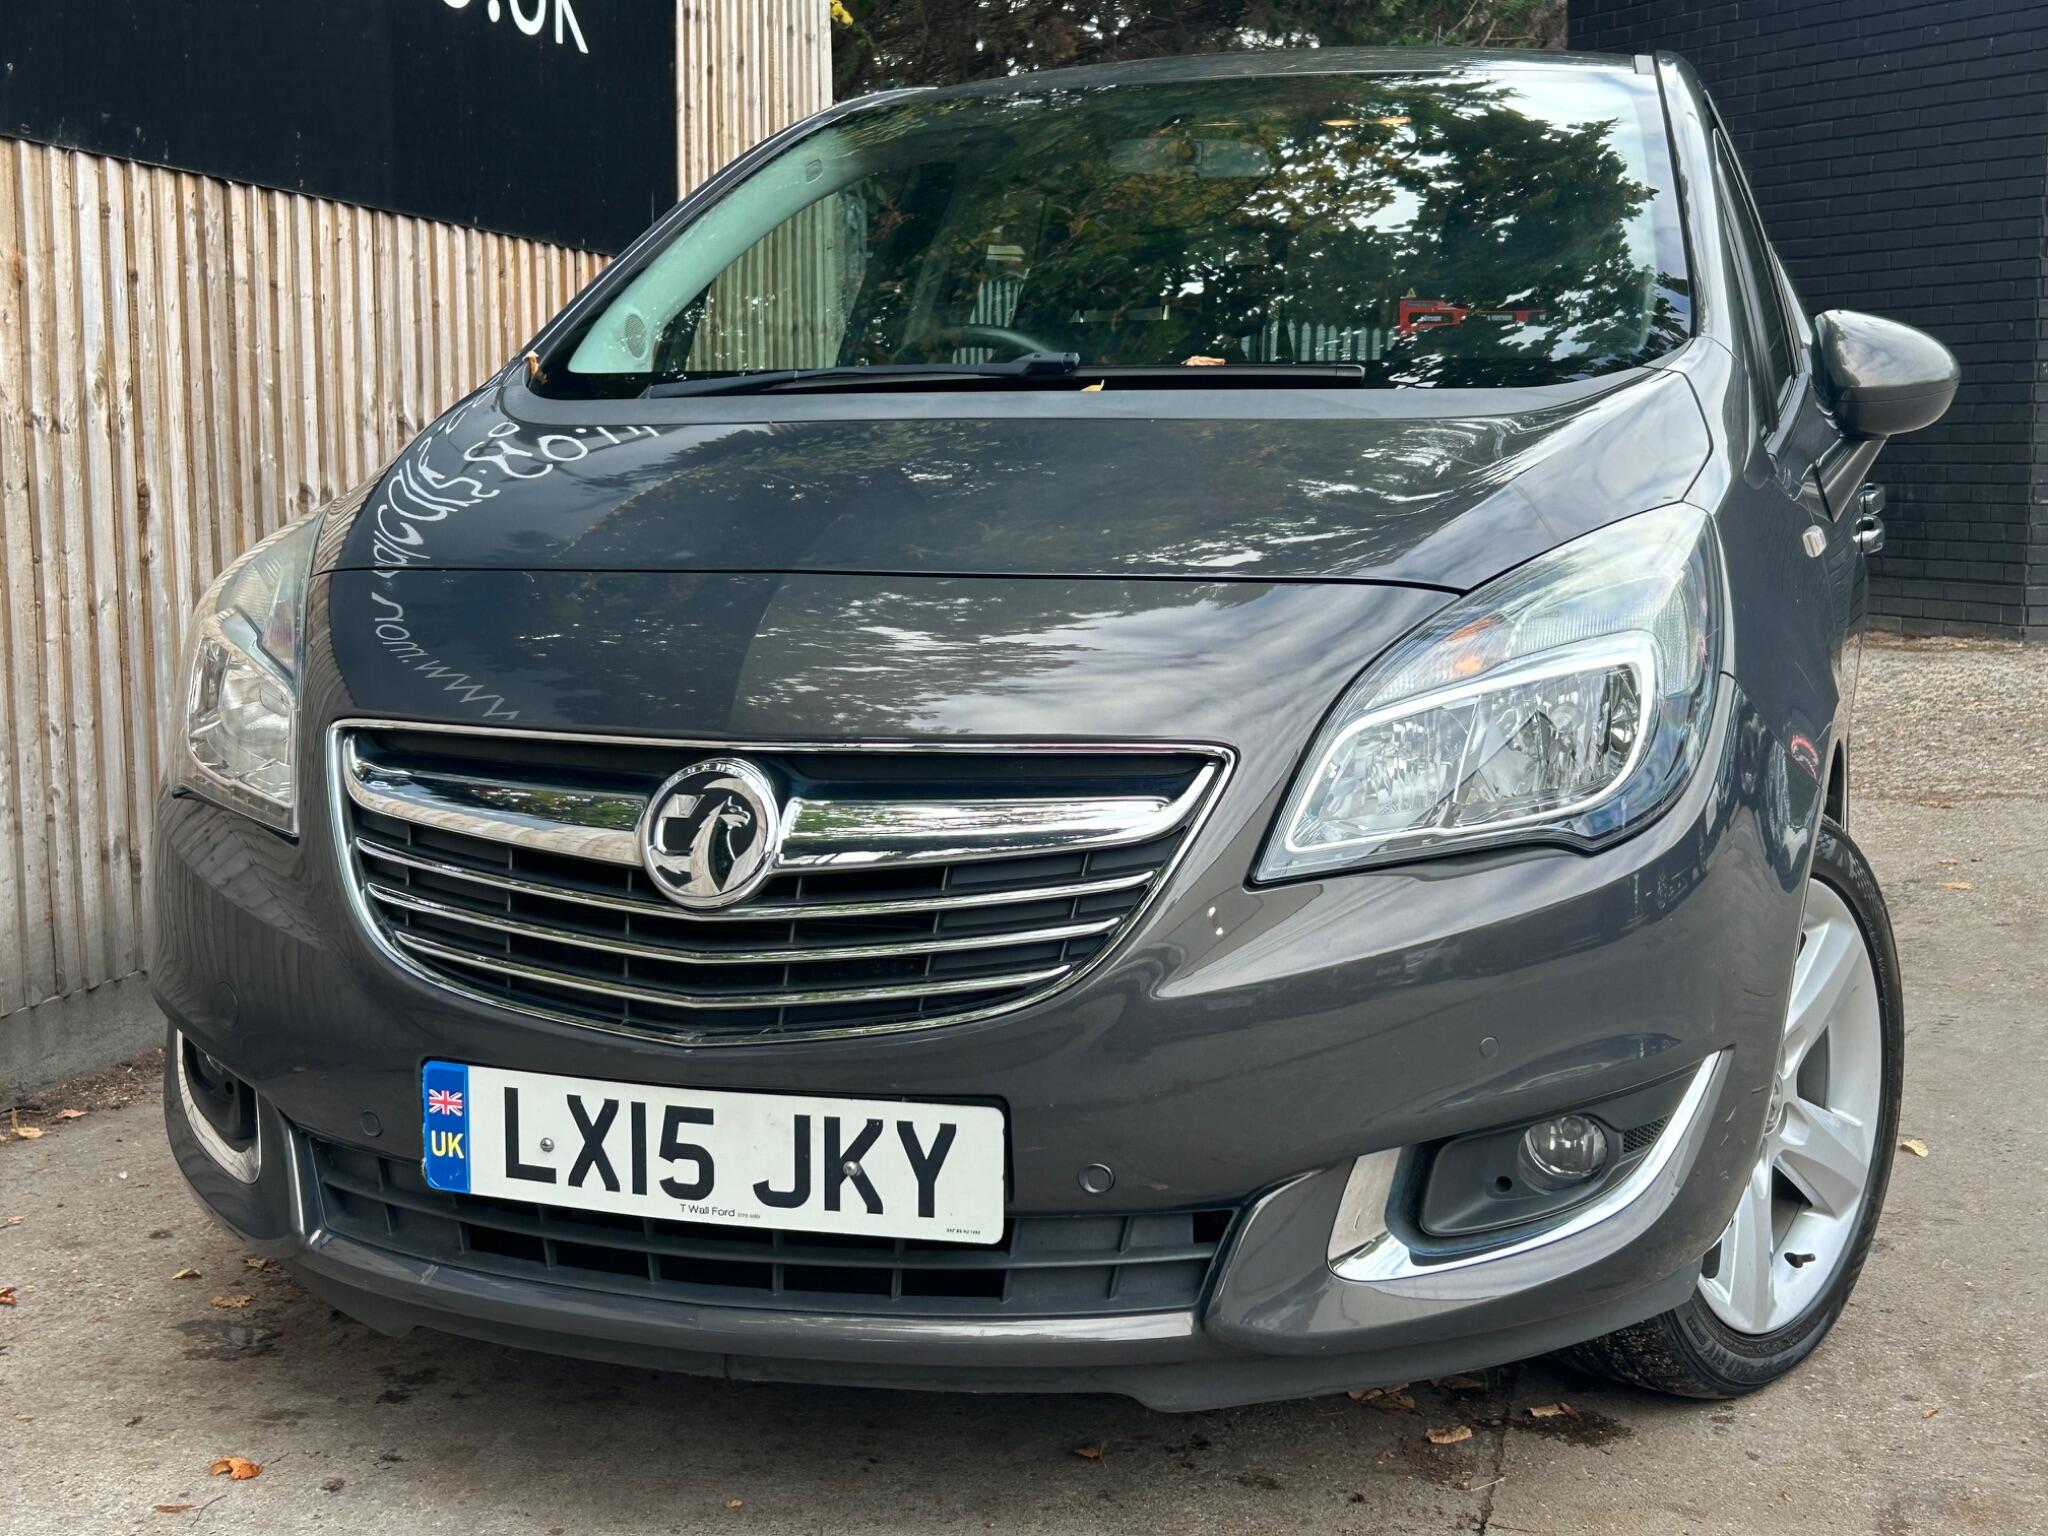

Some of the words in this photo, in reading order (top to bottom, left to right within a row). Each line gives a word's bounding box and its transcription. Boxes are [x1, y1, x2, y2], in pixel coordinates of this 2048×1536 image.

[430, 1130, 465, 1160] UK
[503, 1086, 715, 1201] LX15
[752, 1113, 957, 1219] JKY
[688, 1204, 710, 1215] Wall
[711, 1207, 736, 1217] Ford
